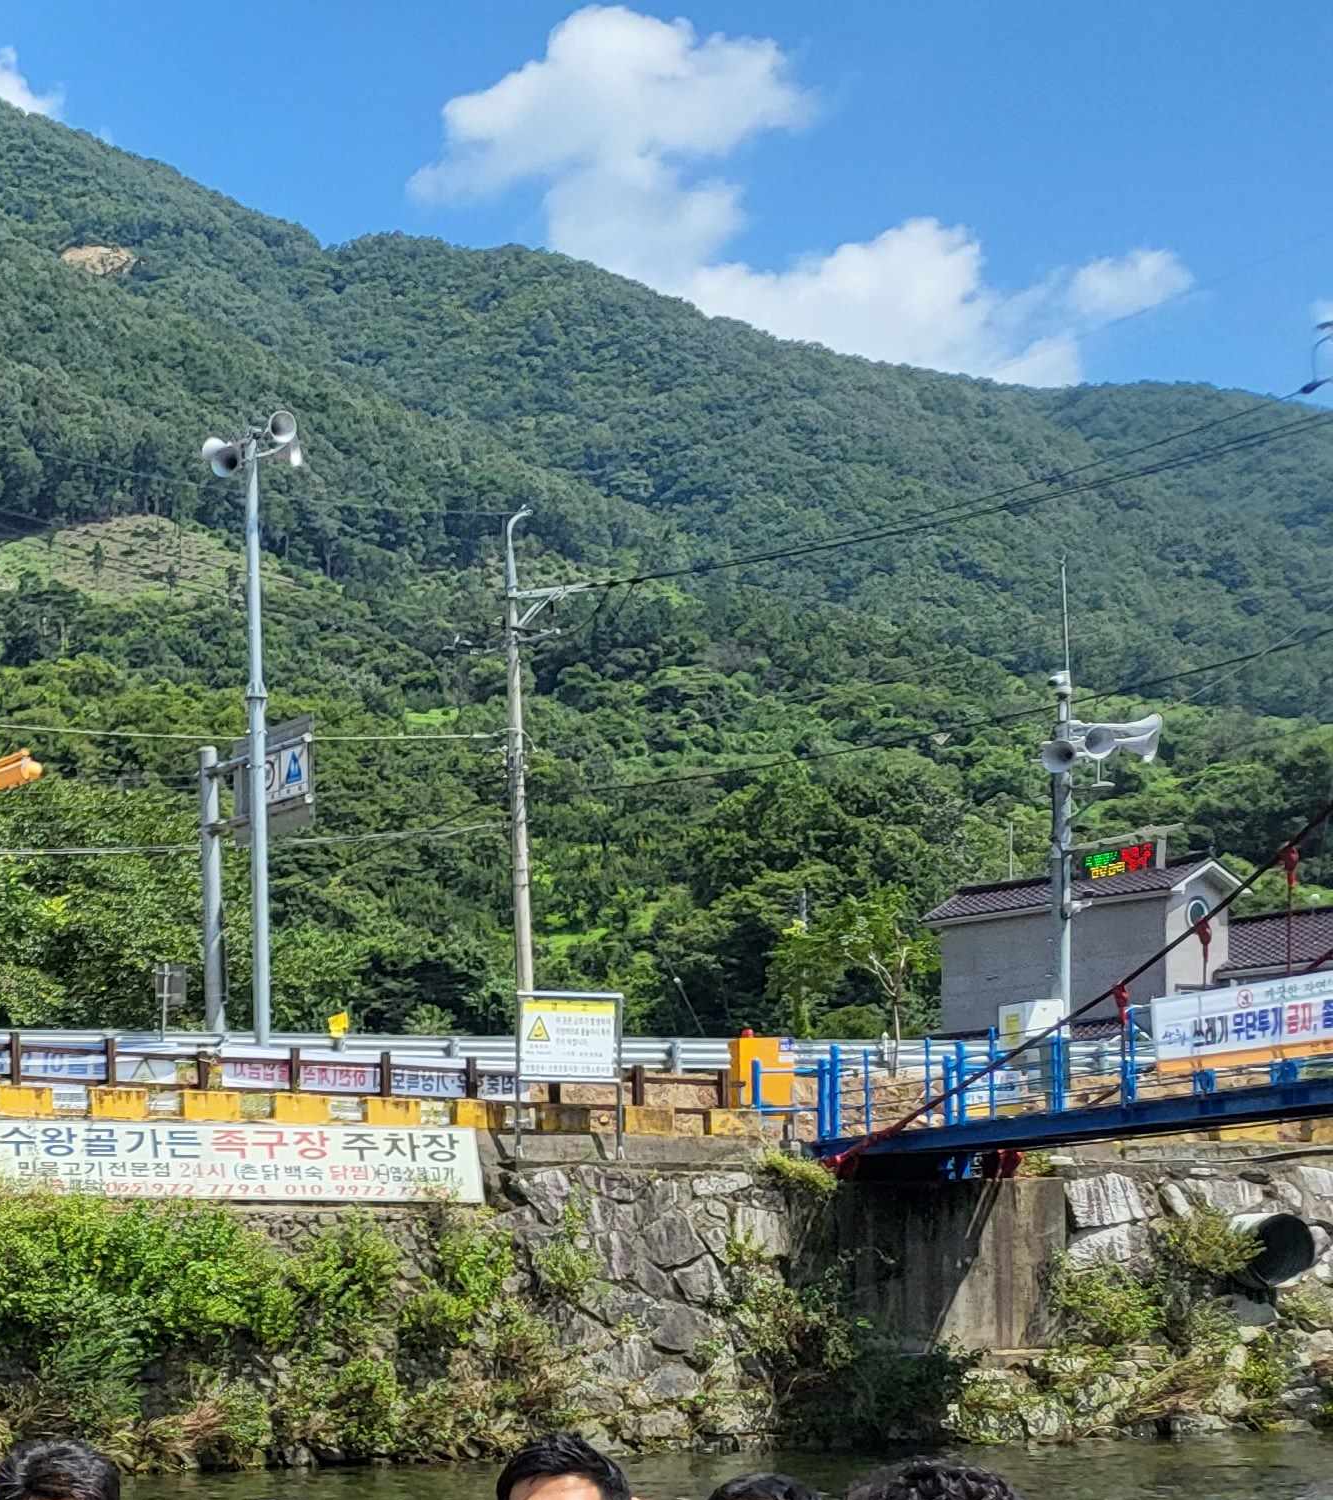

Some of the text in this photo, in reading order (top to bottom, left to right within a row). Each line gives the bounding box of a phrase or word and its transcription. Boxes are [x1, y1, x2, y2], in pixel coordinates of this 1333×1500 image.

[1192, 1015, 1229, 1048] 쓰레기
[1233, 1006, 1283, 1041] 무단투기
[1286, 1002, 1318, 1035] 금지,
[211, 1129, 331, 1160] 족구장
[341, 1132, 460, 1163] 주차장
[179, 1163, 225, 1179] 24시
